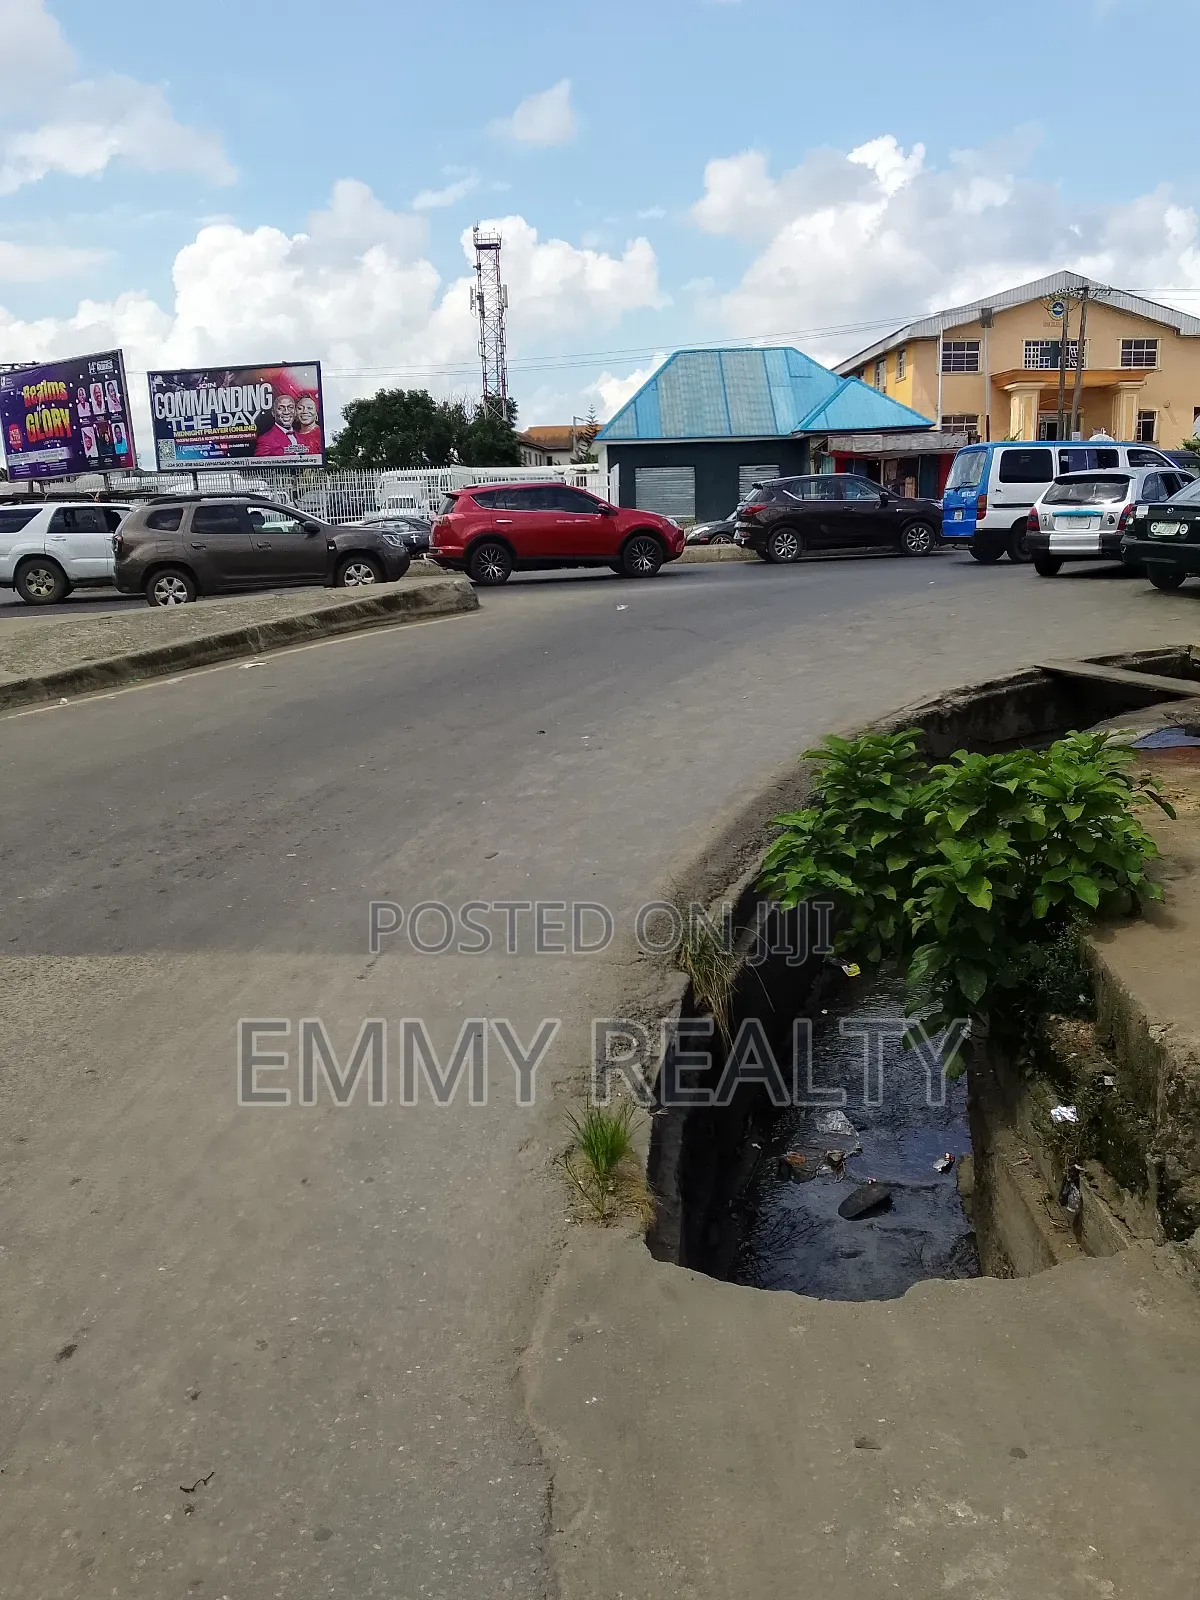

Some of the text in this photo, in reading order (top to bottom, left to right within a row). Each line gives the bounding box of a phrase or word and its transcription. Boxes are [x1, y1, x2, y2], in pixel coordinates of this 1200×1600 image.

[196, 382, 217, 390] JOIN
[154, 383, 273, 419] COMMANDING
[25, 408, 72, 443] GLORY
[166, 410, 261, 432] THE DAY
[173, 429, 205, 438] MIDNIGHT
[205, 427, 229, 436] PRAYER
[229, 424, 258, 434] (ONLINE)
